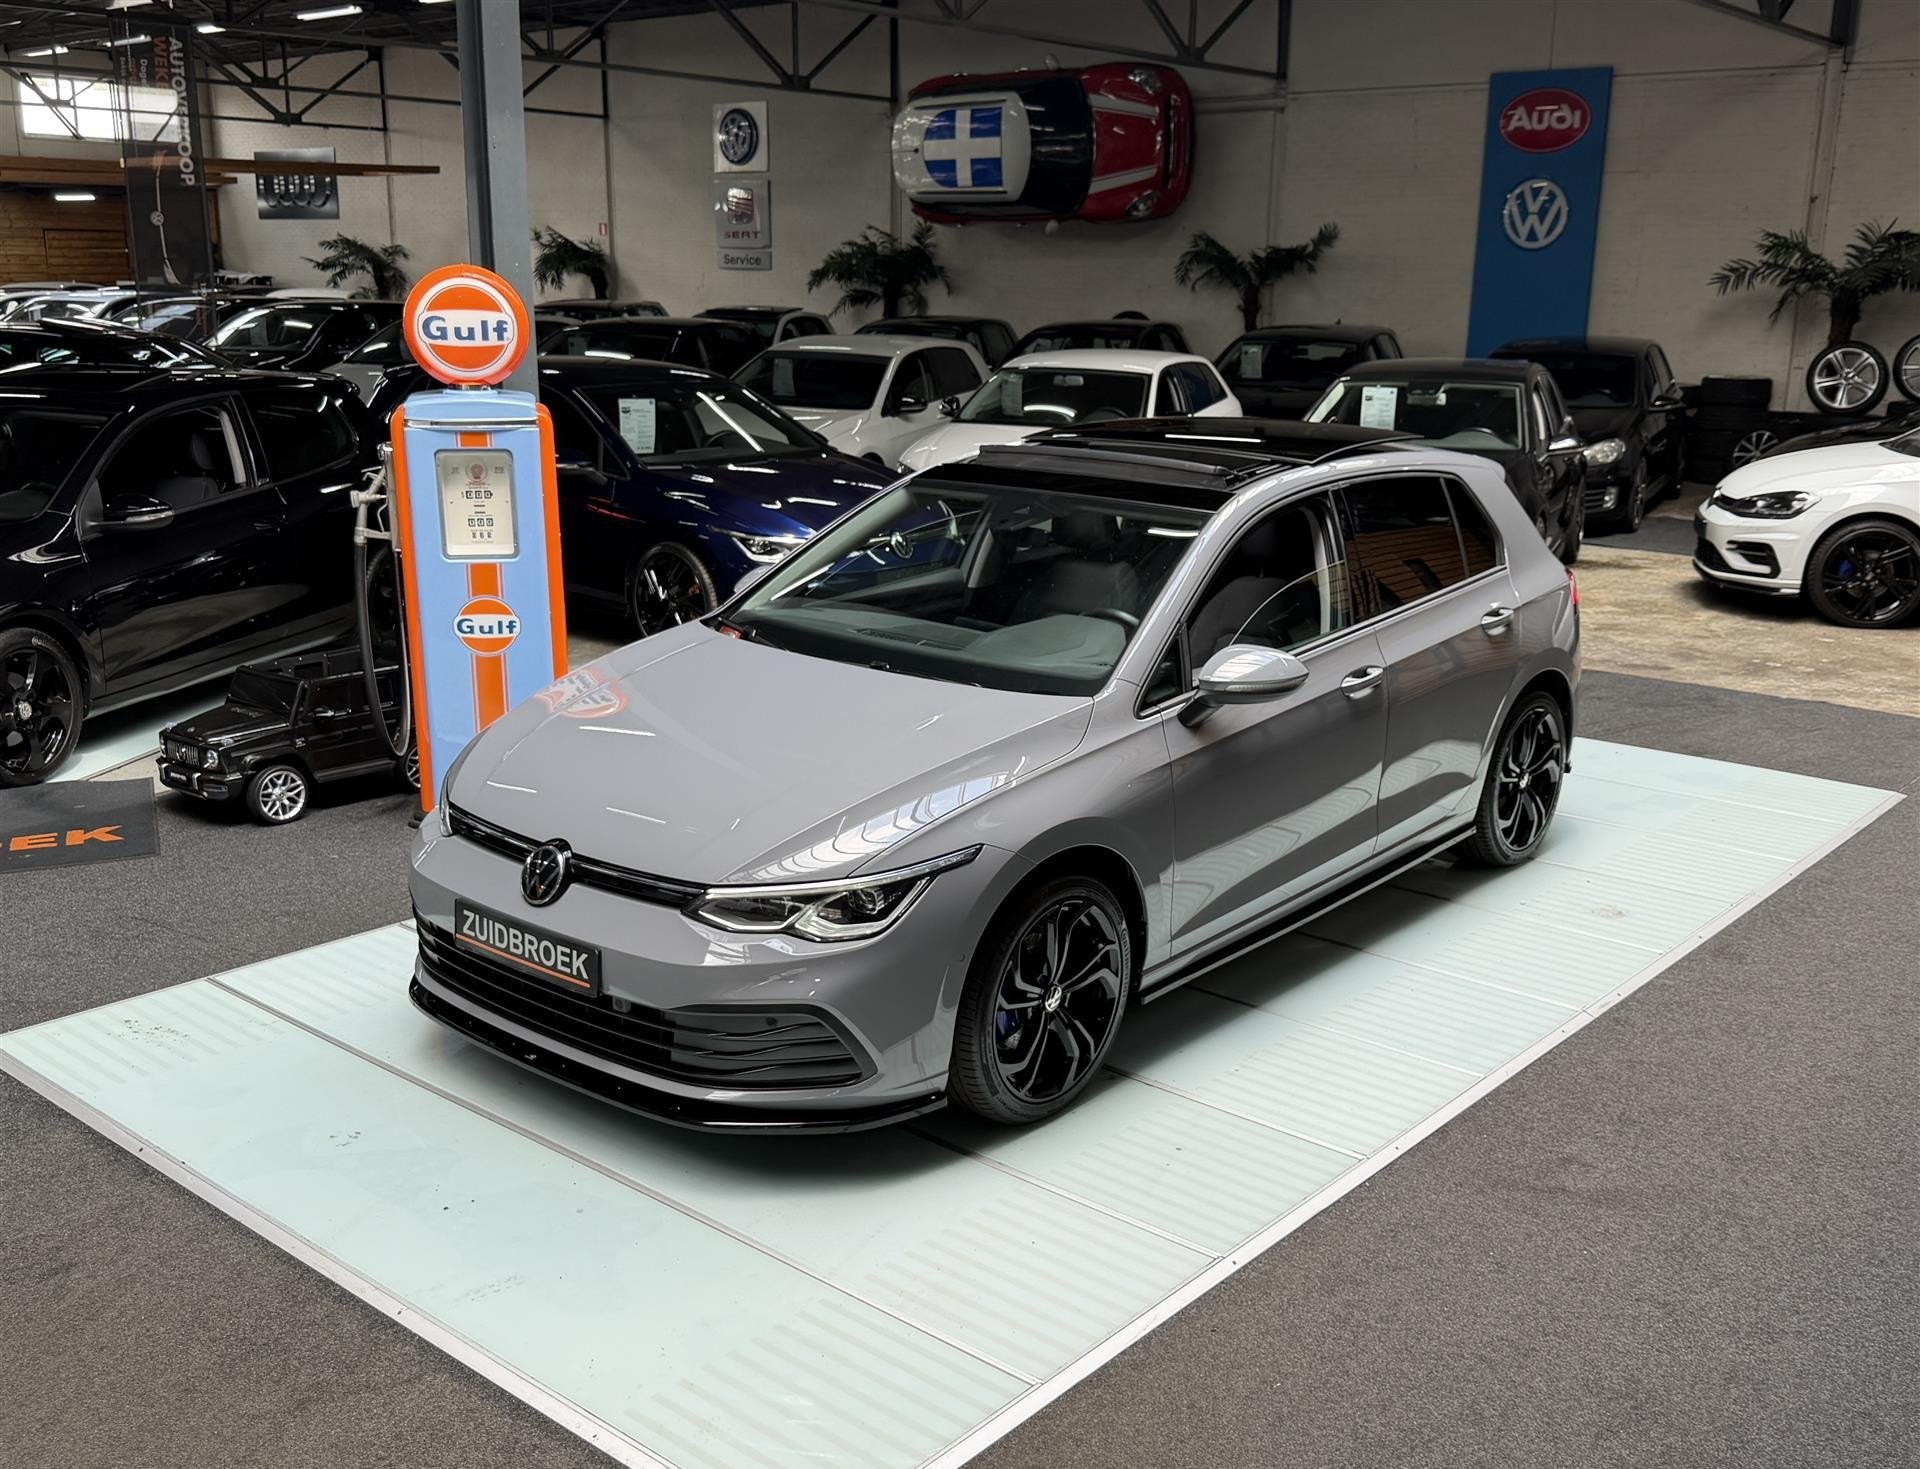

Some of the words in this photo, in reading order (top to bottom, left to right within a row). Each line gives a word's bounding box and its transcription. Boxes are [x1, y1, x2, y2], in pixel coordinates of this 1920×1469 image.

[723, 231, 761, 240] SEAT
[723, 253, 762, 266] Service
[422, 315, 508, 341] Gulf
[456, 618, 517, 635] Gulf
[0, 825, 125, 851] EK
[463, 909, 589, 980] ZUIDBROEK
